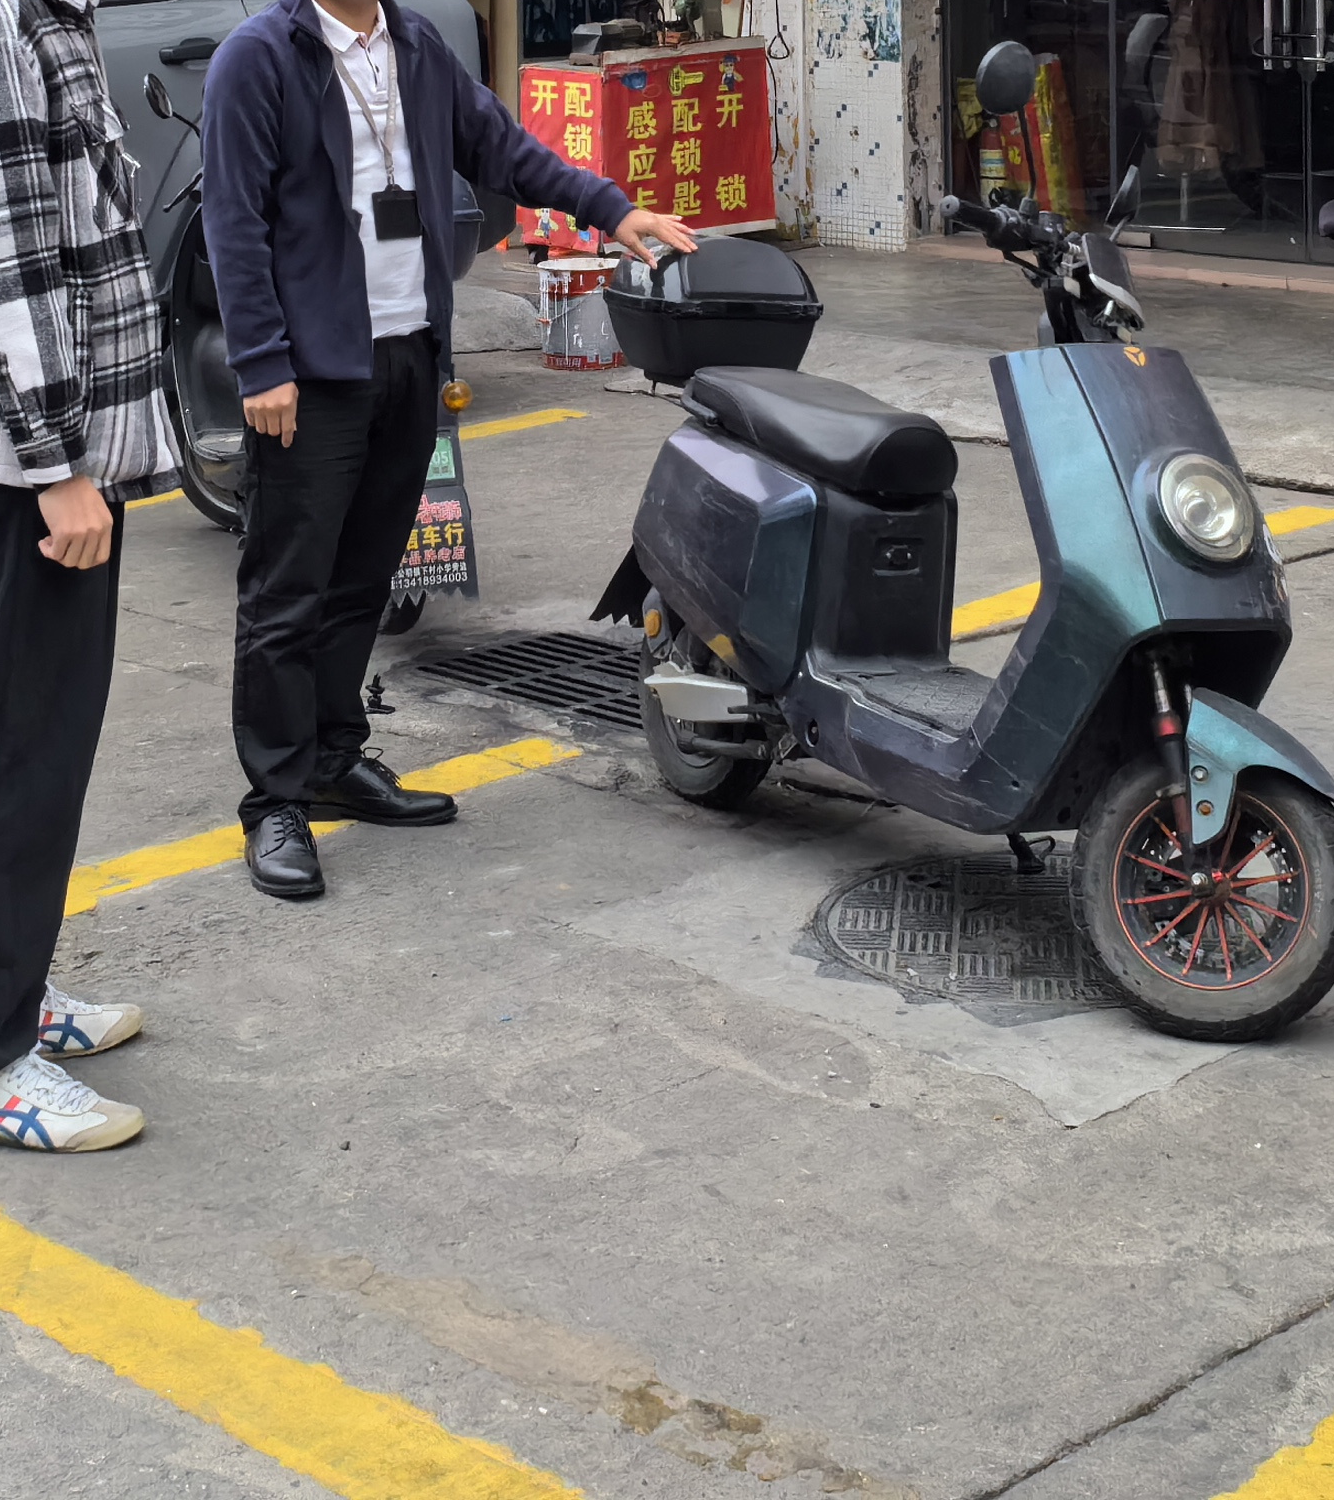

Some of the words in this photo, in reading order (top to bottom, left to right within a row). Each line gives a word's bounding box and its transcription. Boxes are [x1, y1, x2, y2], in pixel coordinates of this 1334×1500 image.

[563, 81, 594, 172] 配锁
[671, 97, 703, 217] 配锁匙
